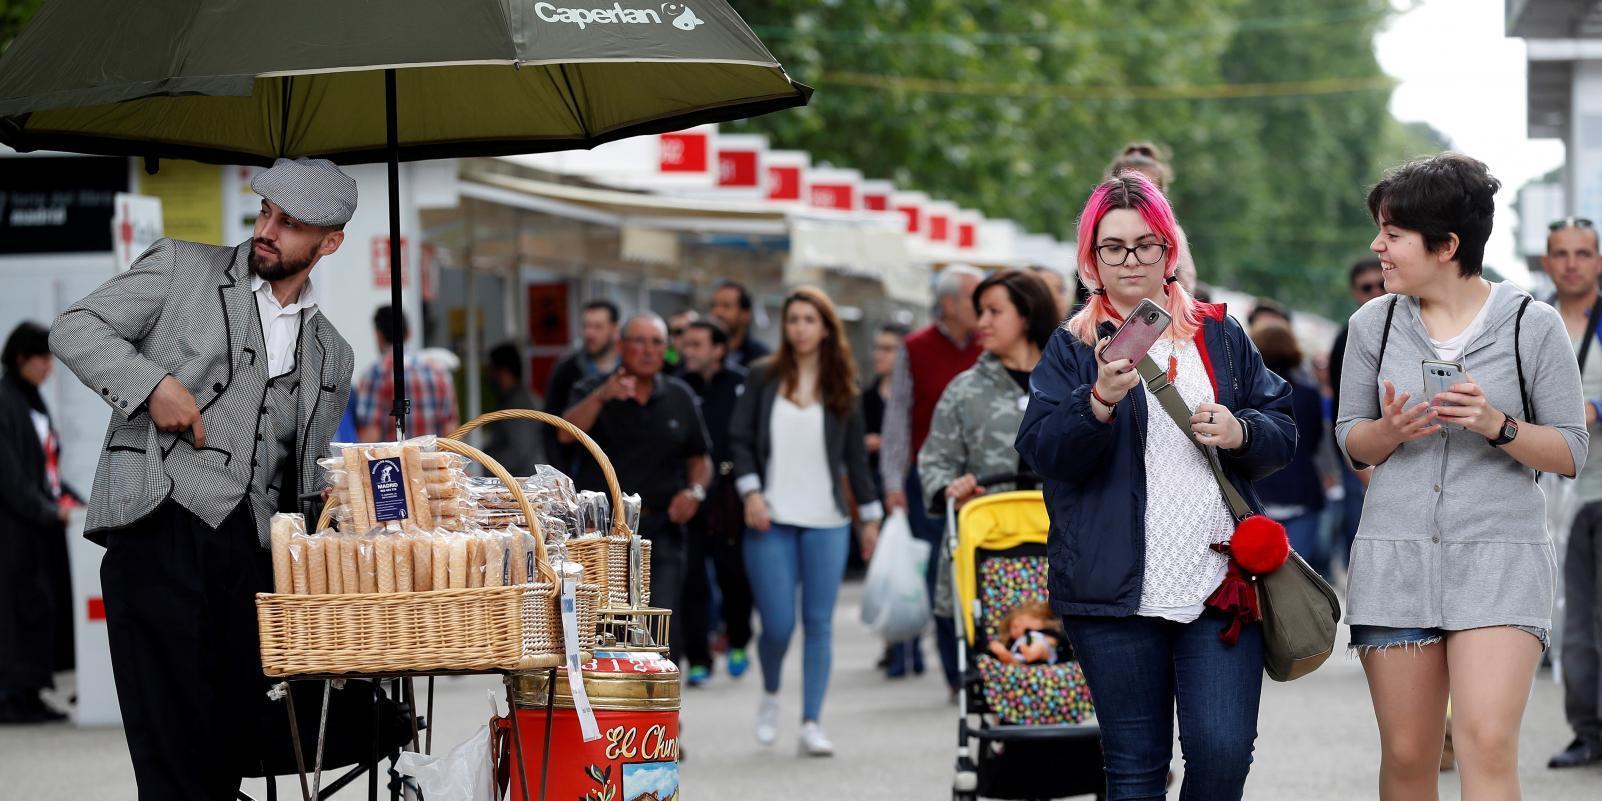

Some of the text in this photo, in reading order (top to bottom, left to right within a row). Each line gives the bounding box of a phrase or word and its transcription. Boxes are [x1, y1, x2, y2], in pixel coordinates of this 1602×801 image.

[534, 2, 662, 30] Caperlan
[377, 482, 399, 490] MADRID
[610, 658, 622, 672] 1
[605, 725, 638, 760] El
